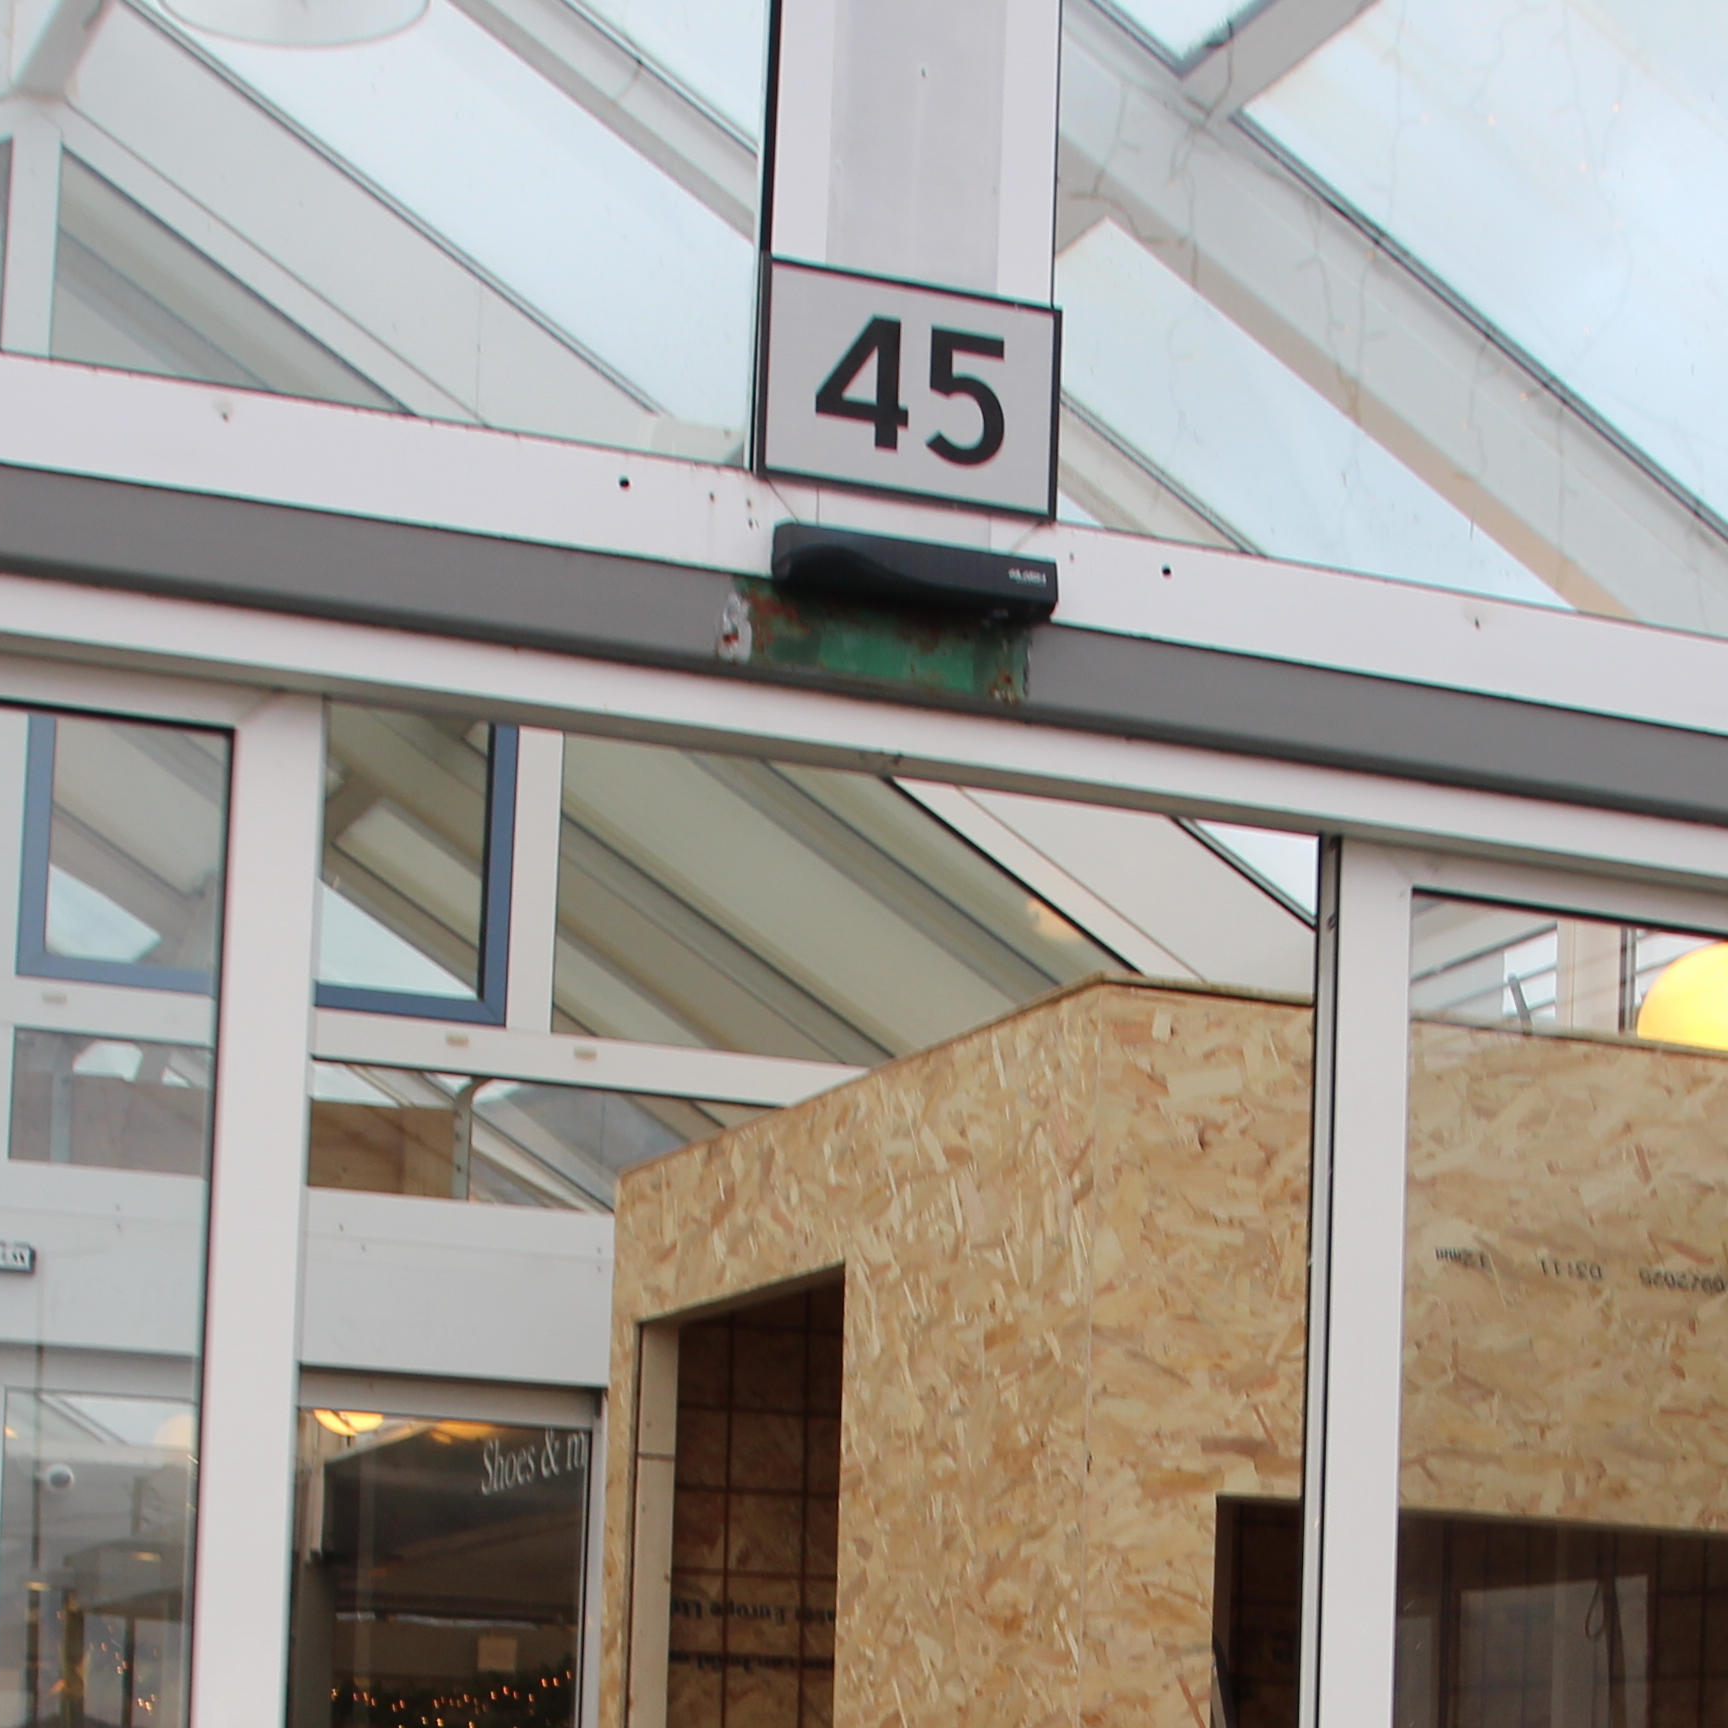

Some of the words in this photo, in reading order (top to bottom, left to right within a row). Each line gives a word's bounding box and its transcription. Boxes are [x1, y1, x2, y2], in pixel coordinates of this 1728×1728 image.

[815, 315, 1005, 467] 45
[481, 1438, 536, 1496] Shoes
[541, 1427, 560, 1478] &
